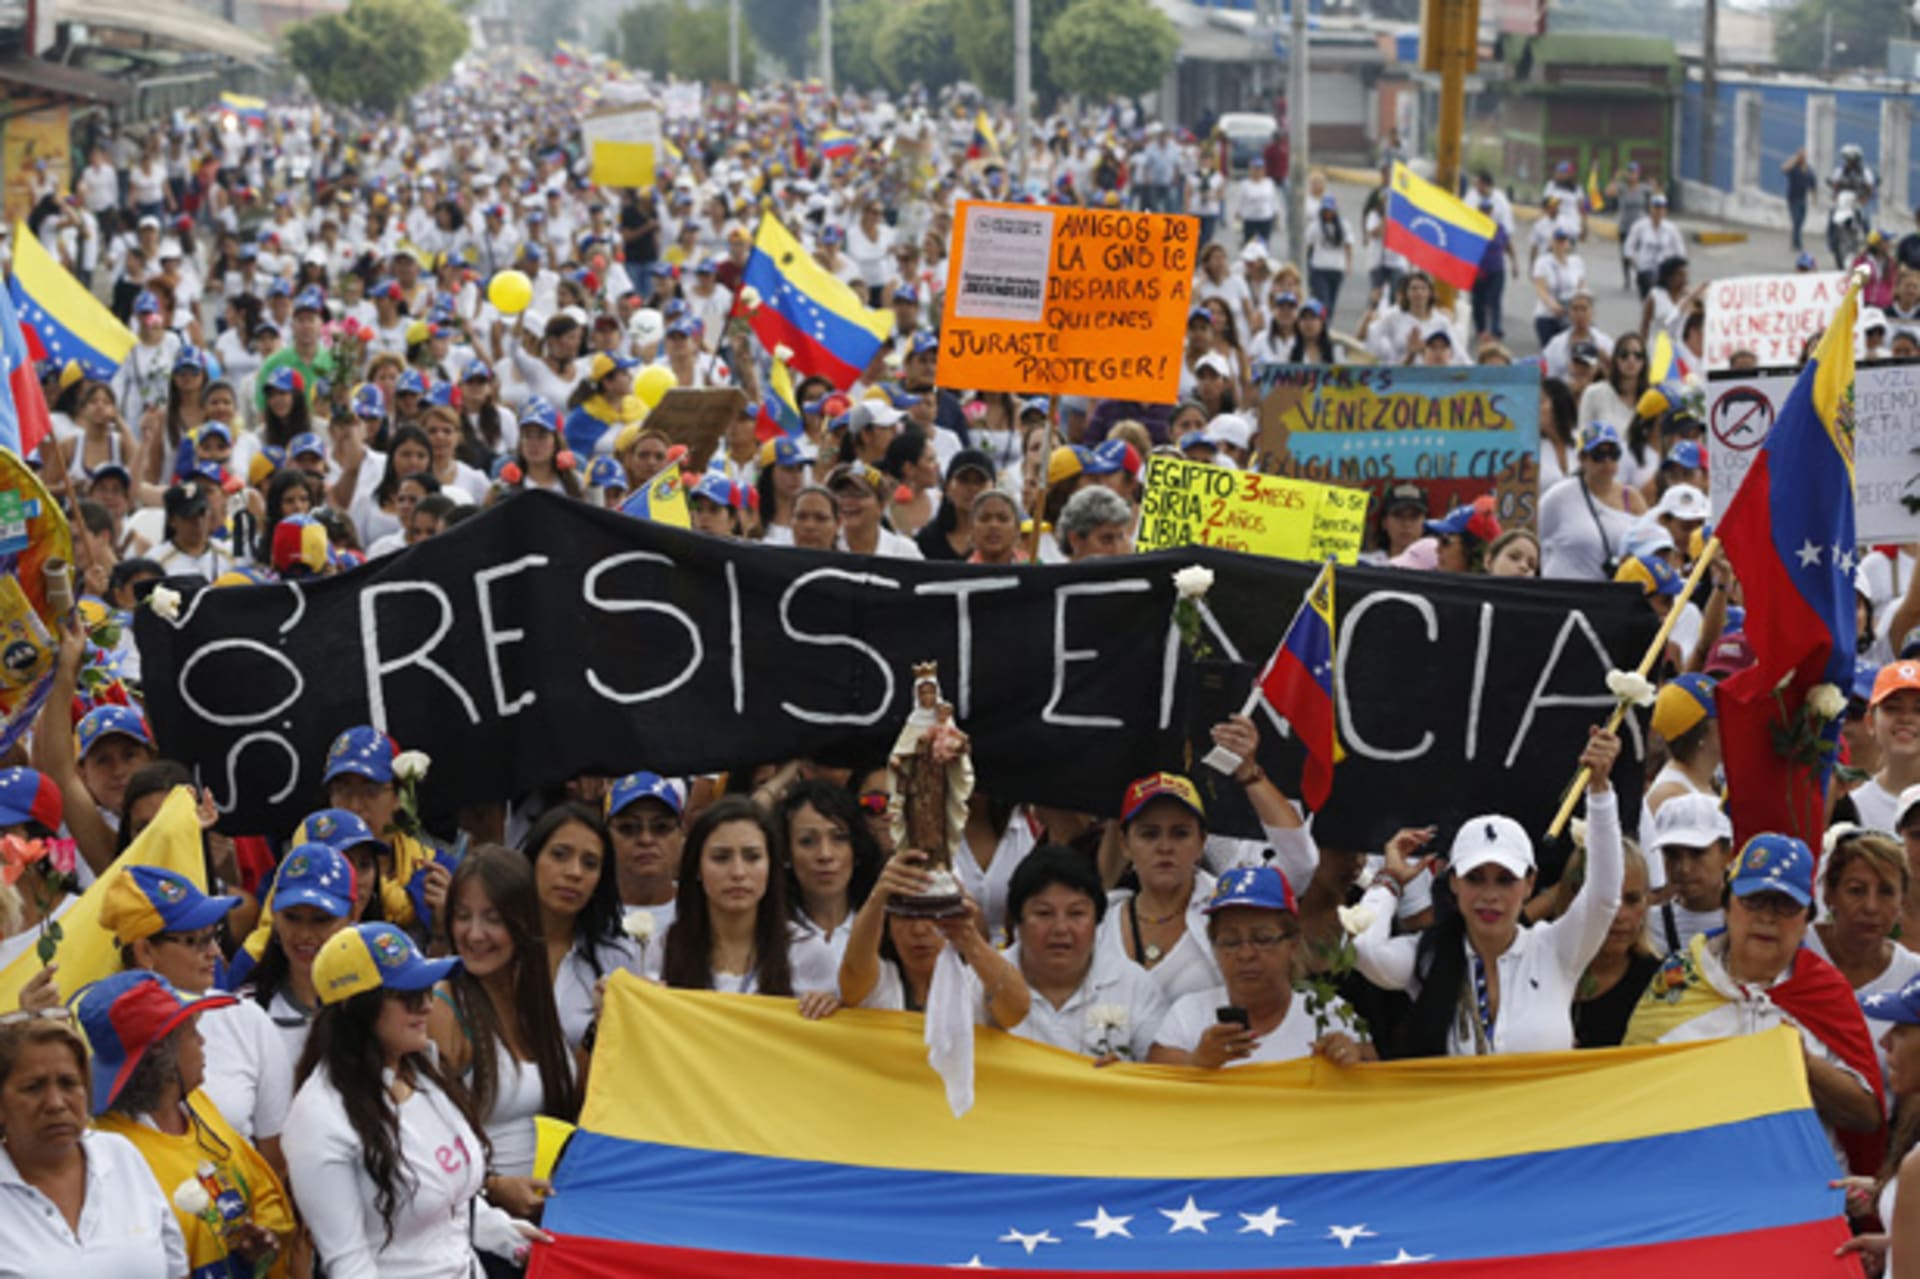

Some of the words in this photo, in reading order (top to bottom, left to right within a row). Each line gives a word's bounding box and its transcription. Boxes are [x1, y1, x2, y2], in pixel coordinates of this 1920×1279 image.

[1057, 214, 1150, 243] AMIGOS
[1057, 243, 1086, 271] LA
[1047, 275, 1161, 301] DISPARAS
[1169, 279, 1186, 300] A
[1719, 280, 1796, 309] QUIERO
[1046, 307, 1153, 331] QUIENES
[1720, 308, 1836, 337] VENEZUEL
[948, 329, 1058, 358] JURASTE
[1013, 355, 1167, 383] PROTEGER!
[1296, 394, 1507, 431] VENEZOLANAS
[1262, 451, 1395, 481] EXIGIMOS
[1415, 451, 1457, 478] QUE
[1469, 448, 1535, 484] CESE
[1241, 474, 1262, 502] 3
[1207, 499, 1227, 526] 2
[360, 551, 1645, 768] RESISTENCIA
